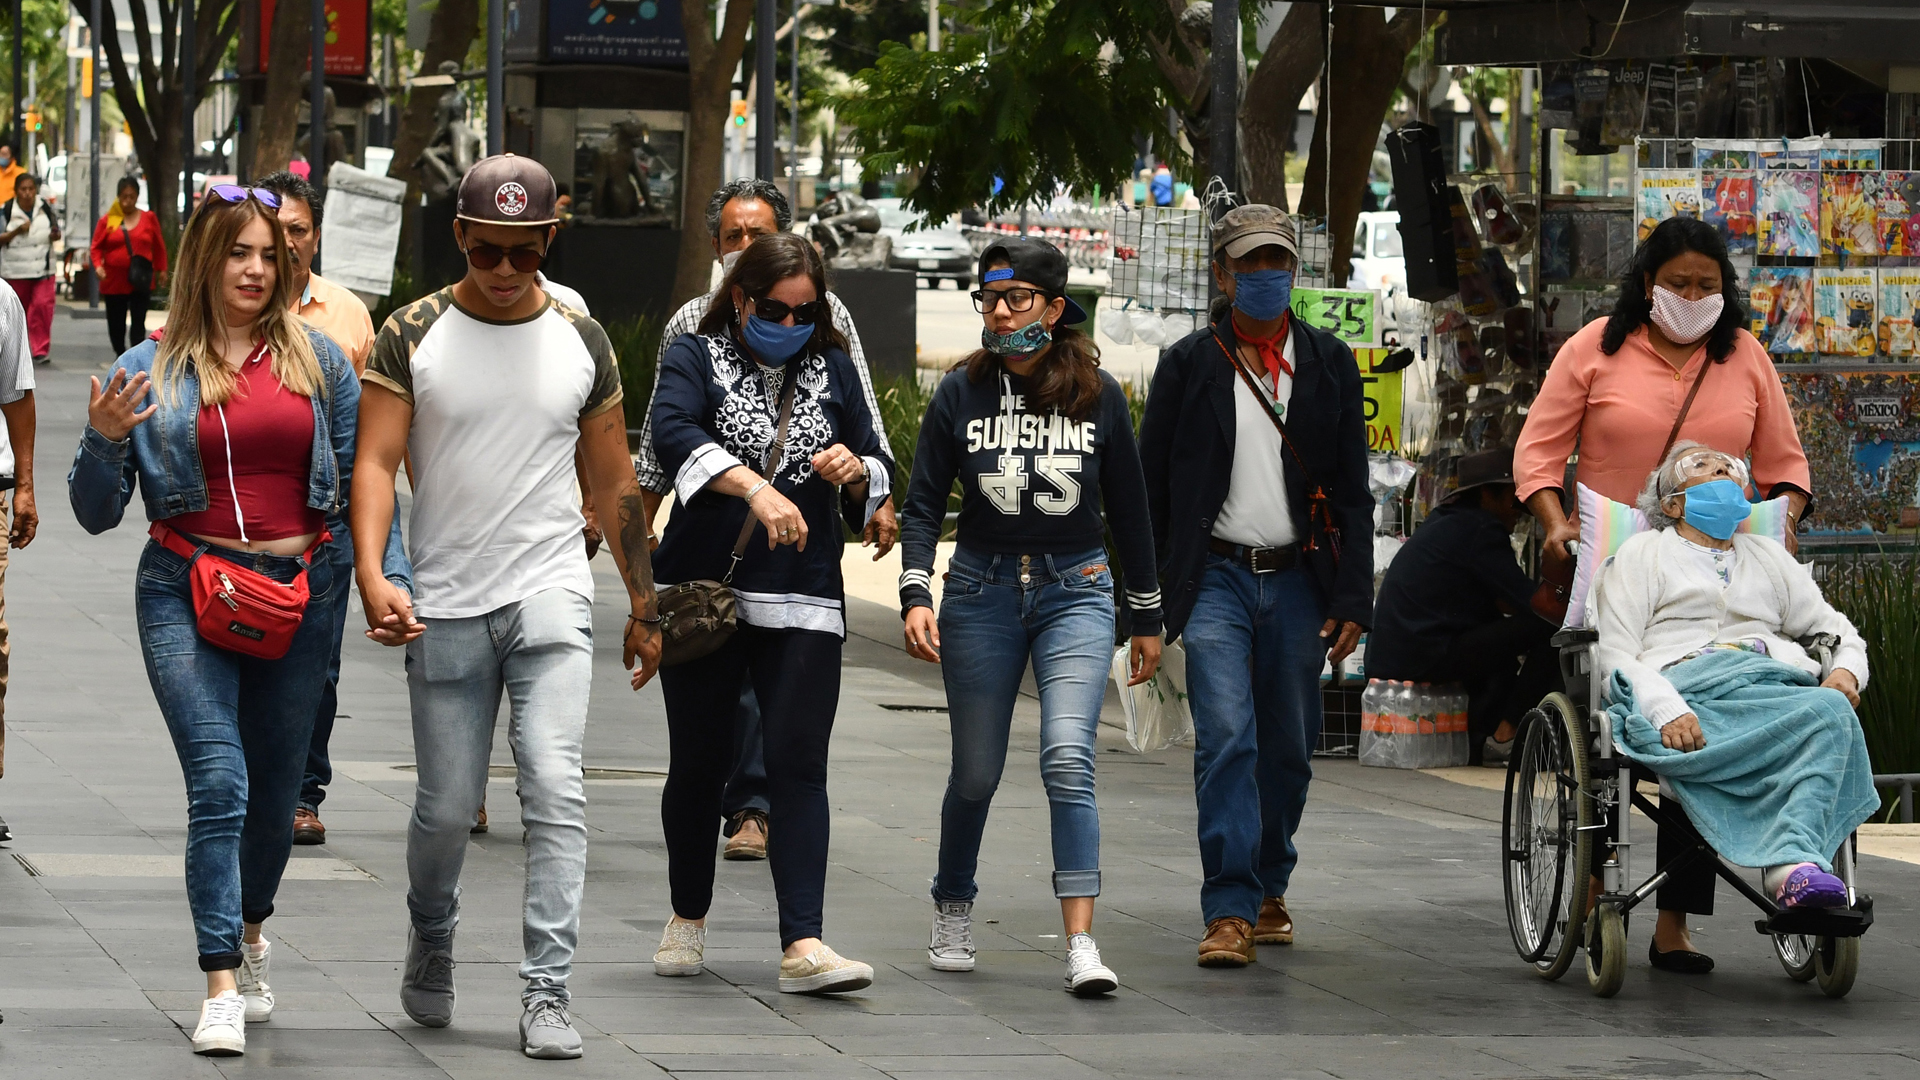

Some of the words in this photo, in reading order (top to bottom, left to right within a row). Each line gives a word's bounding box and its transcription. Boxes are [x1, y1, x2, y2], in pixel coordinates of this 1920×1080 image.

[1615, 67, 1644, 85] Jeep
[500, 184, 523, 195] SEÑOR
[1642, 178, 1696, 188] minions
[1320, 296, 1366, 338] 35
[966, 414, 1096, 454] SUNSHINE
